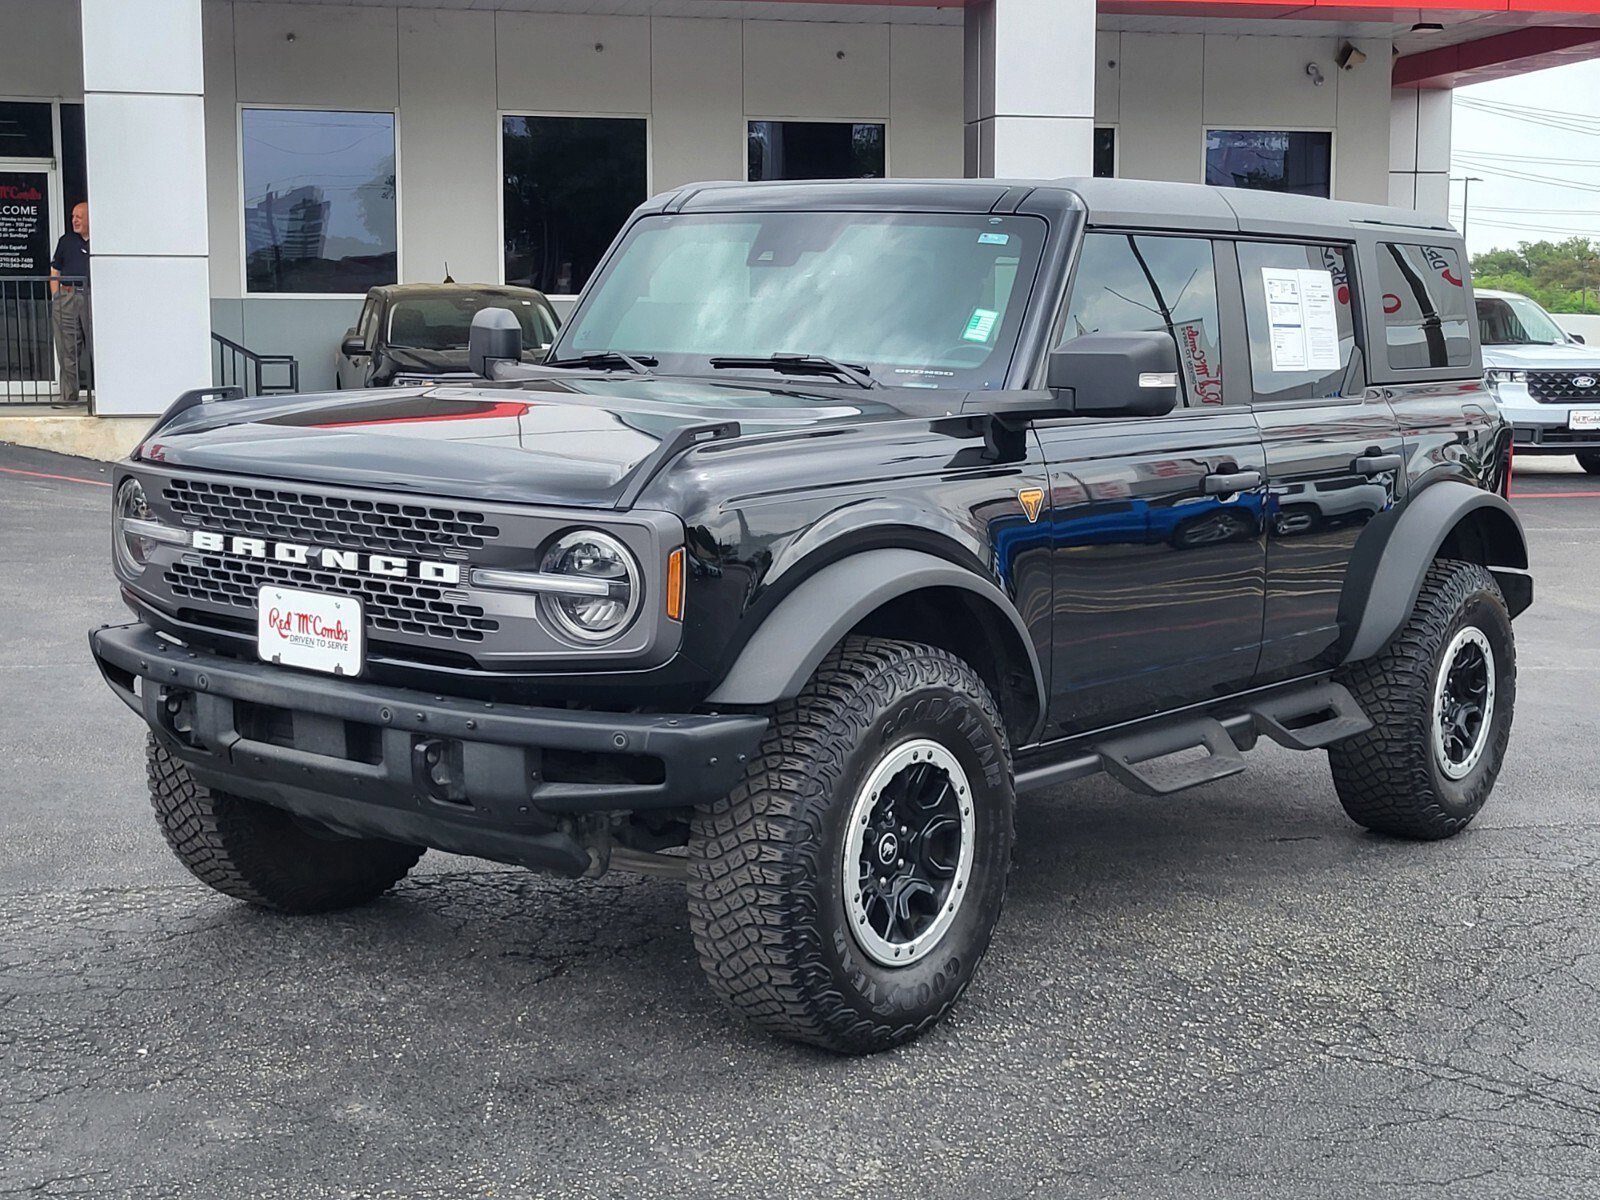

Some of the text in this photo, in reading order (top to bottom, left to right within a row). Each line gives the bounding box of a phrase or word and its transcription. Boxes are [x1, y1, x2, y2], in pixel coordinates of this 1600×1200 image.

[193, 531, 460, 584] BRONCO
[269, 607, 349, 642] Red McCombs
[289, 634, 349, 652] DRIVEN TO SERVE
